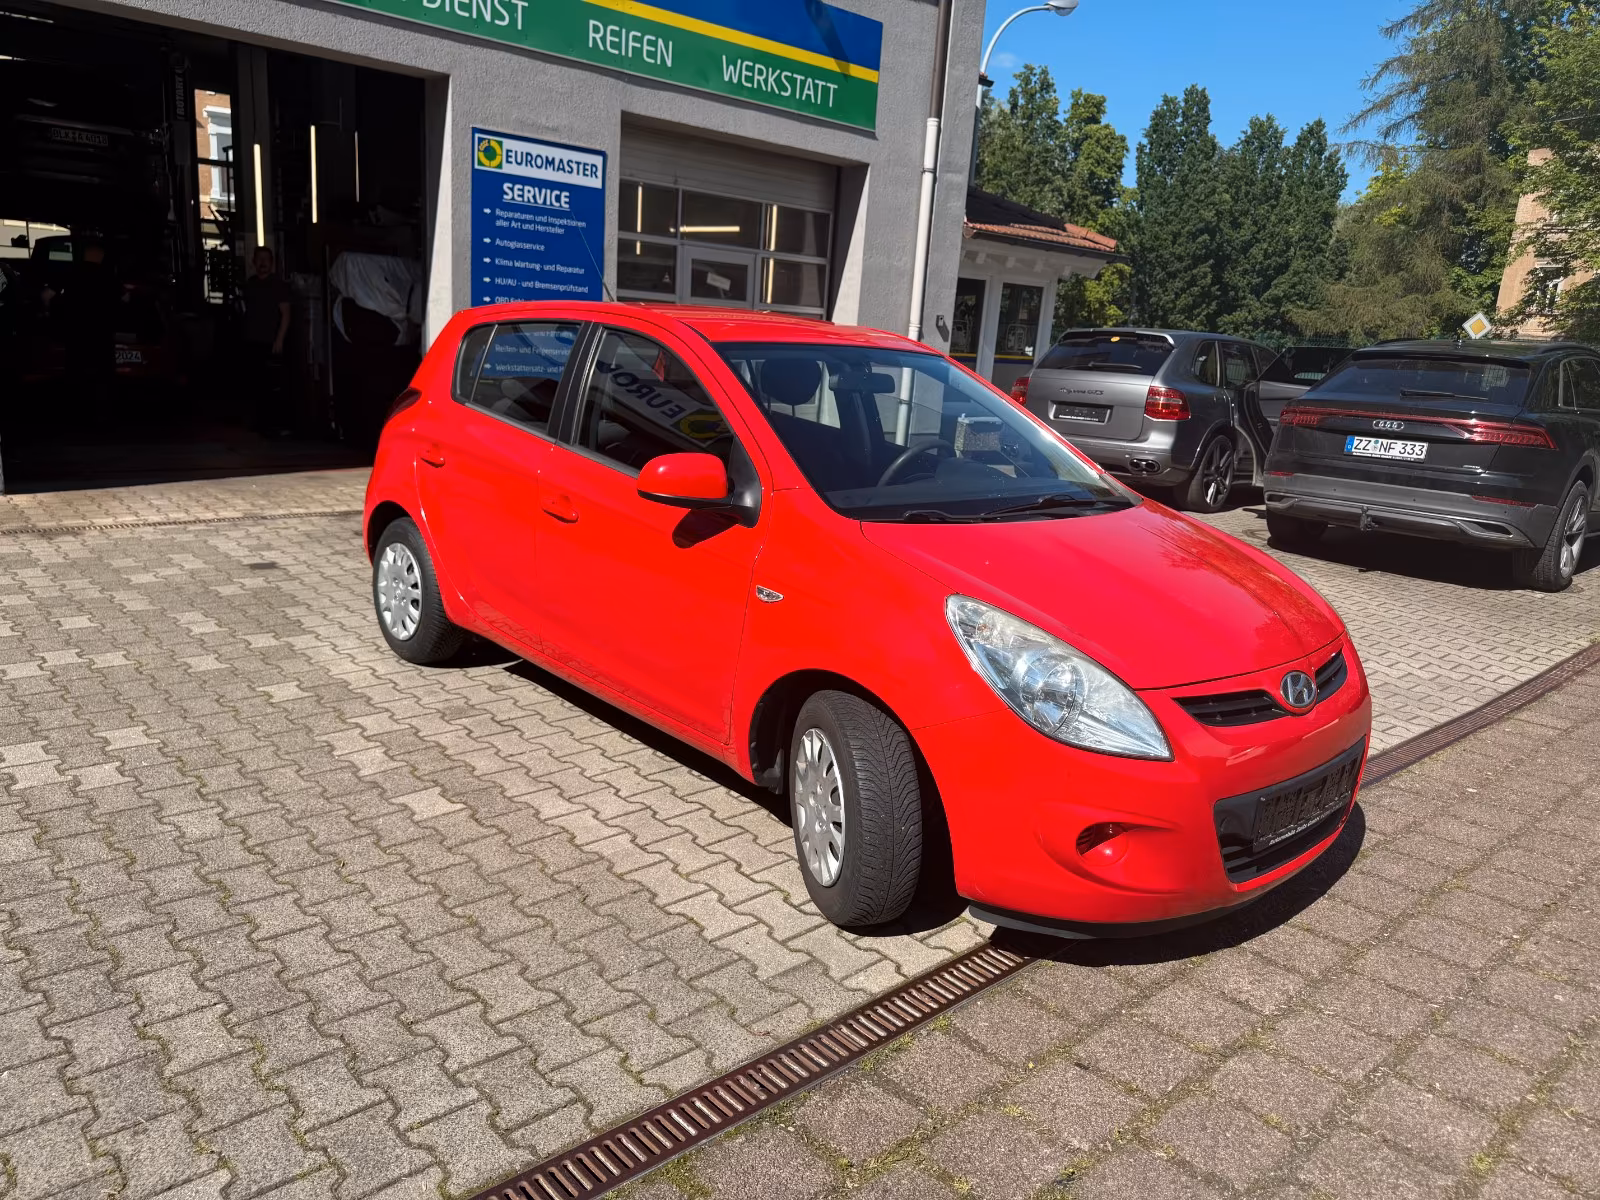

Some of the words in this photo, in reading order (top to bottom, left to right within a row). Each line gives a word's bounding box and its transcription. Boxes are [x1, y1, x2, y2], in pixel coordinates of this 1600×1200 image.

[589, 19, 672, 67] REIFEN
[722, 55, 838, 108] WERKSTATT
[505, 149, 599, 179] EUROMASTER
[502, 182, 570, 208] SERVICE
[495, 208, 534, 221] Reparaturen
[548, 216, 587, 228] Inspektionen
[495, 219, 510, 227] aller
[511, 220, 521, 229] Art
[522, 223, 534, 231] und
[535, 225, 565, 234] Hersteller
[495, 238, 545, 251] Autoglasservice
[495, 258, 513, 267] Klima
[556, 264, 585, 275] Reparatur
[495, 277, 517, 286] HU/AU
[535, 281, 589, 293] Bremsenprüfstand
[519, 345, 531, 354] und
[547, 364, 558, 373] und
[1354, 439, 1372, 451] ZZ
[1379, 441, 1397, 454] NF
[1399, 443, 1425, 456] 333
